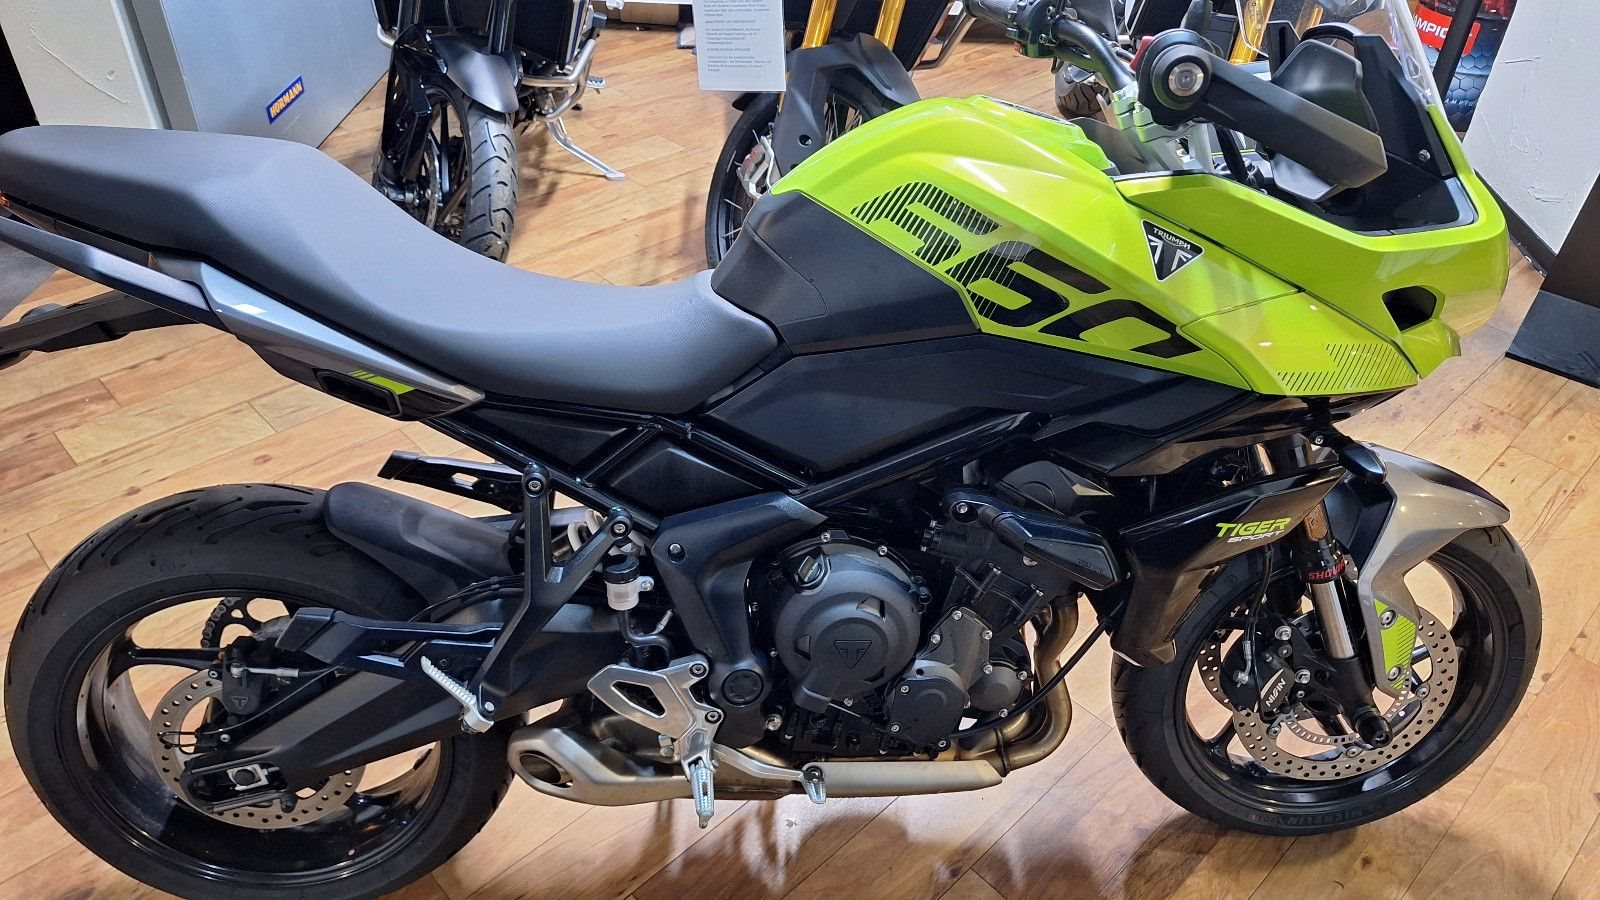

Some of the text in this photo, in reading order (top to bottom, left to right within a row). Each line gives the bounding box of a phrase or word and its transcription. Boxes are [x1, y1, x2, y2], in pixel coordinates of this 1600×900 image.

[1152, 227, 1191, 250] TRIUMPH
[1215, 517, 1292, 538] TIGER
[1226, 530, 1285, 543] SPORT
